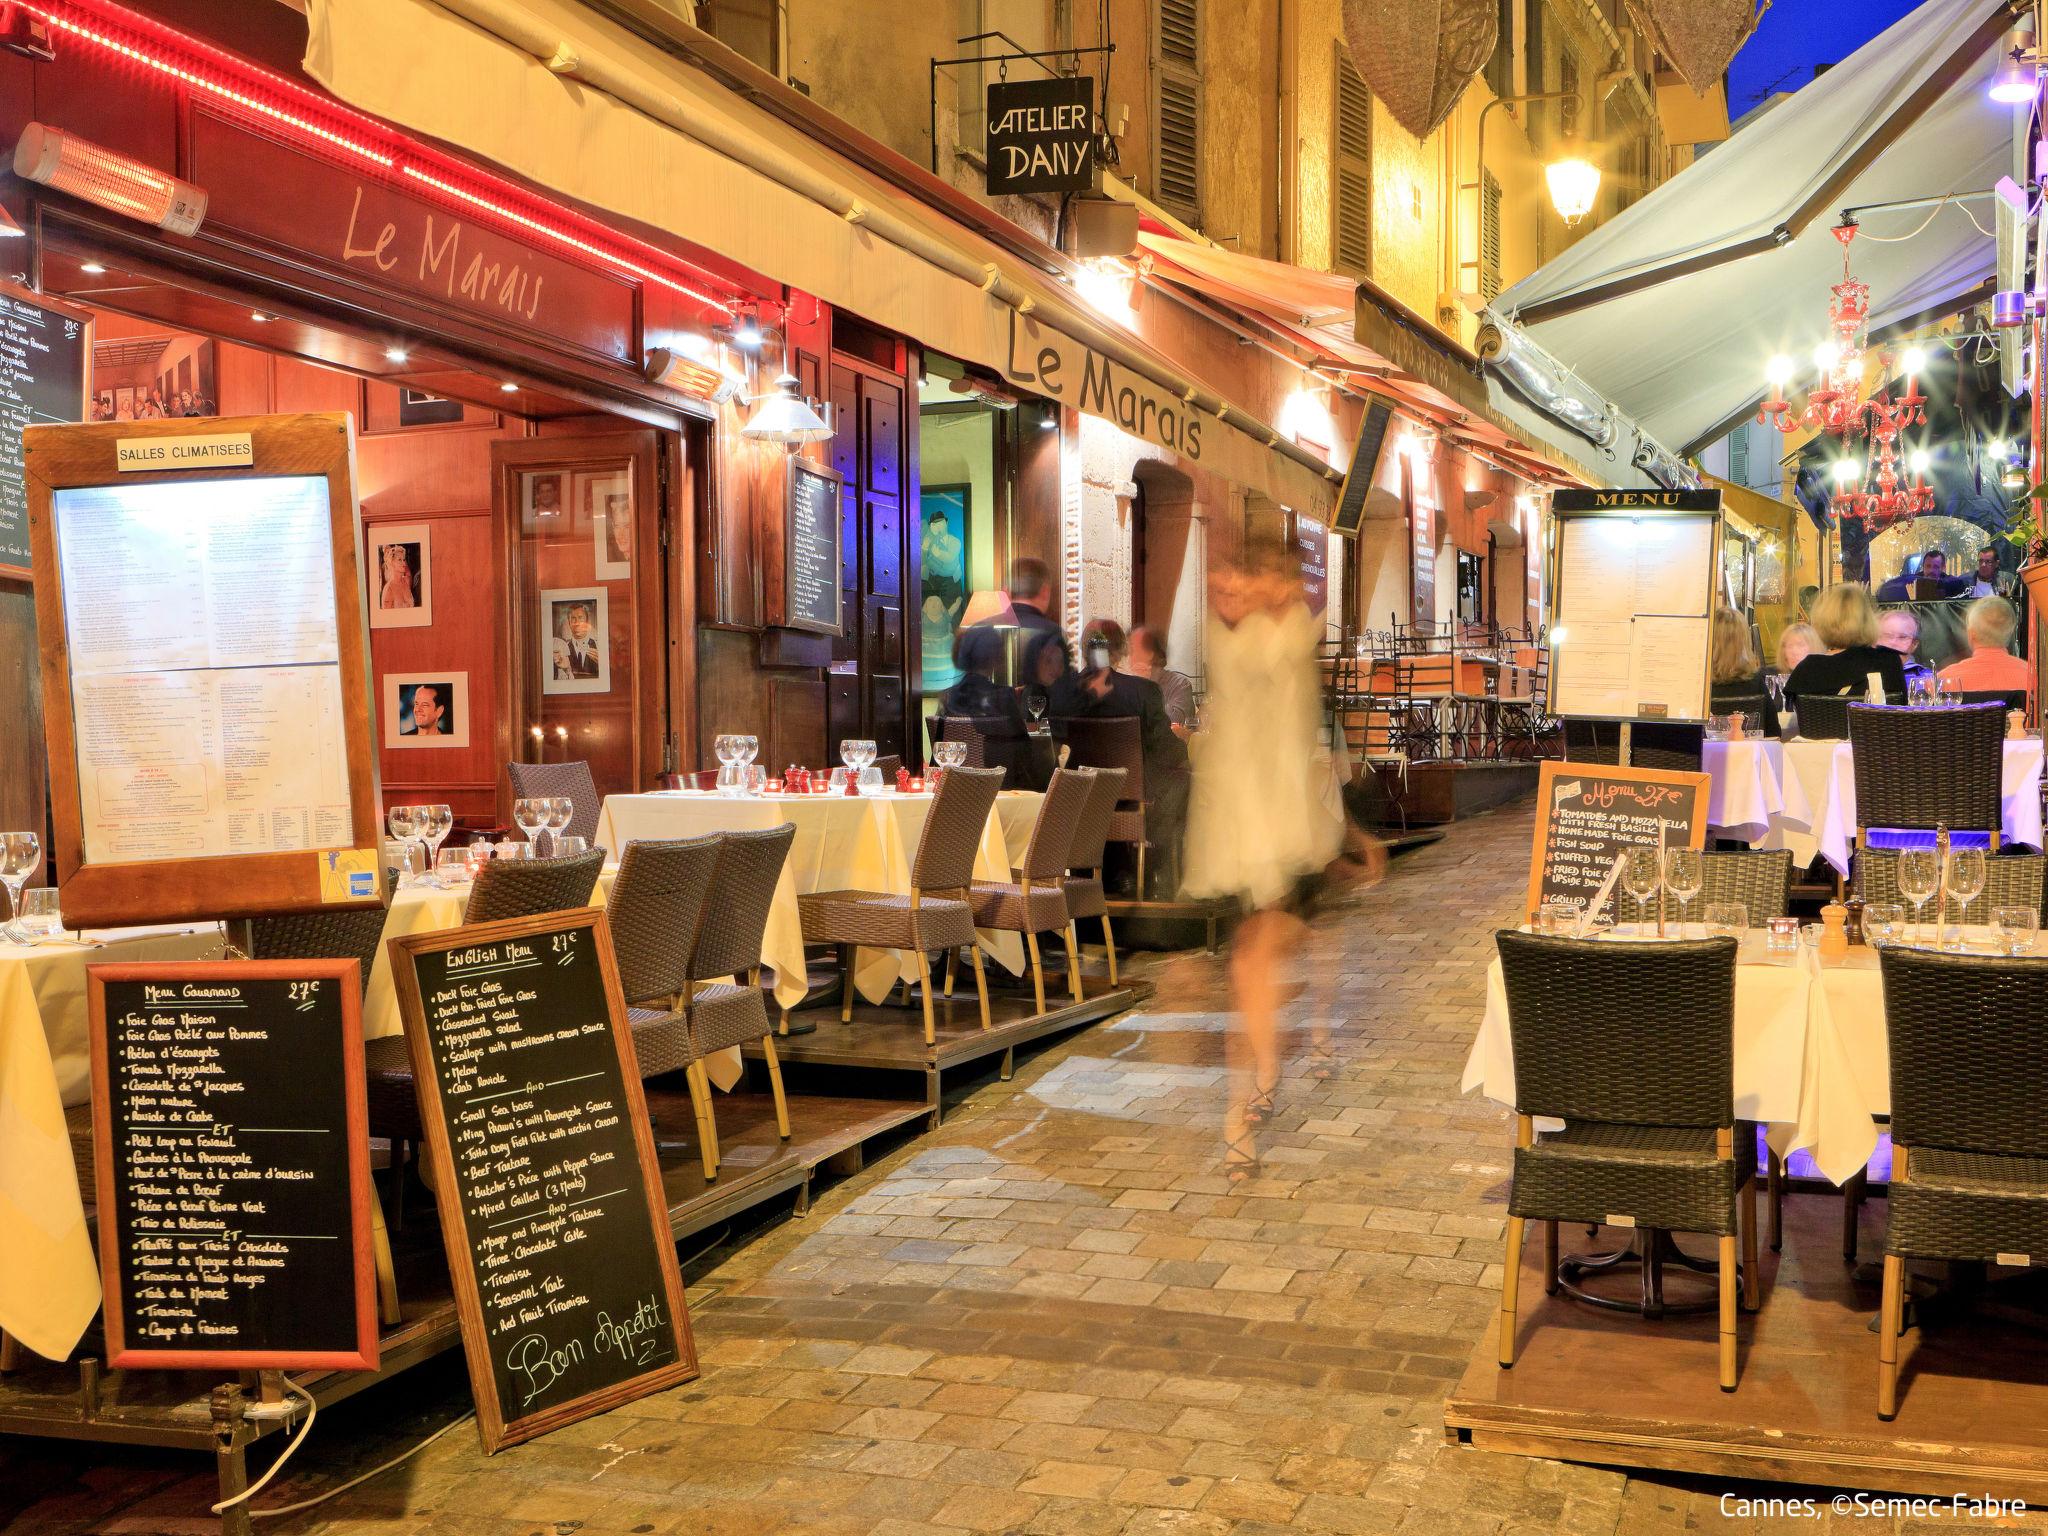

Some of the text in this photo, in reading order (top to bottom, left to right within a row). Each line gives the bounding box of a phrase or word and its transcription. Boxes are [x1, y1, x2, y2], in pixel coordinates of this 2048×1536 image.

[989, 104, 1087, 135] ATELIER
[999, 140, 1089, 179] DANY
[342, 185, 543, 320] Le Marais
[1008, 307, 1202, 461] Le Marais
[119, 442, 251, 462] SALLES CLIMATISEES
[1596, 492, 1681, 506] MENU
[1582, 781, 1637, 808] Menu
[1588, 820, 1617, 831] FRESH
[1609, 814, 1629, 823] AND
[1631, 816, 1688, 831] MOZZAELLA
[506, 942, 533, 964] Menu
[552, 931, 577, 952] 27€
[145, 984, 176, 1004] Menu
[288, 980, 320, 1000] 27€
[460, 984, 479, 998] Foie
[126, 1012, 148, 1026] Foie
[180, 1012, 216, 1030] Maison
[449, 1047, 485, 1064] Scallops
[488, 1040, 508, 1054] with
[460, 1108, 486, 1124] Small
[491, 1105, 510, 1117] Sea
[212, 1123, 234, 1136] ET
[543, 1165, 562, 1179] with
[222, 1229, 243, 1242] ET
[487, 1268, 532, 1288] Tiramisu
[545, 1294, 590, 1316] Tiramisu
[507, 1333, 585, 1407] Bon
